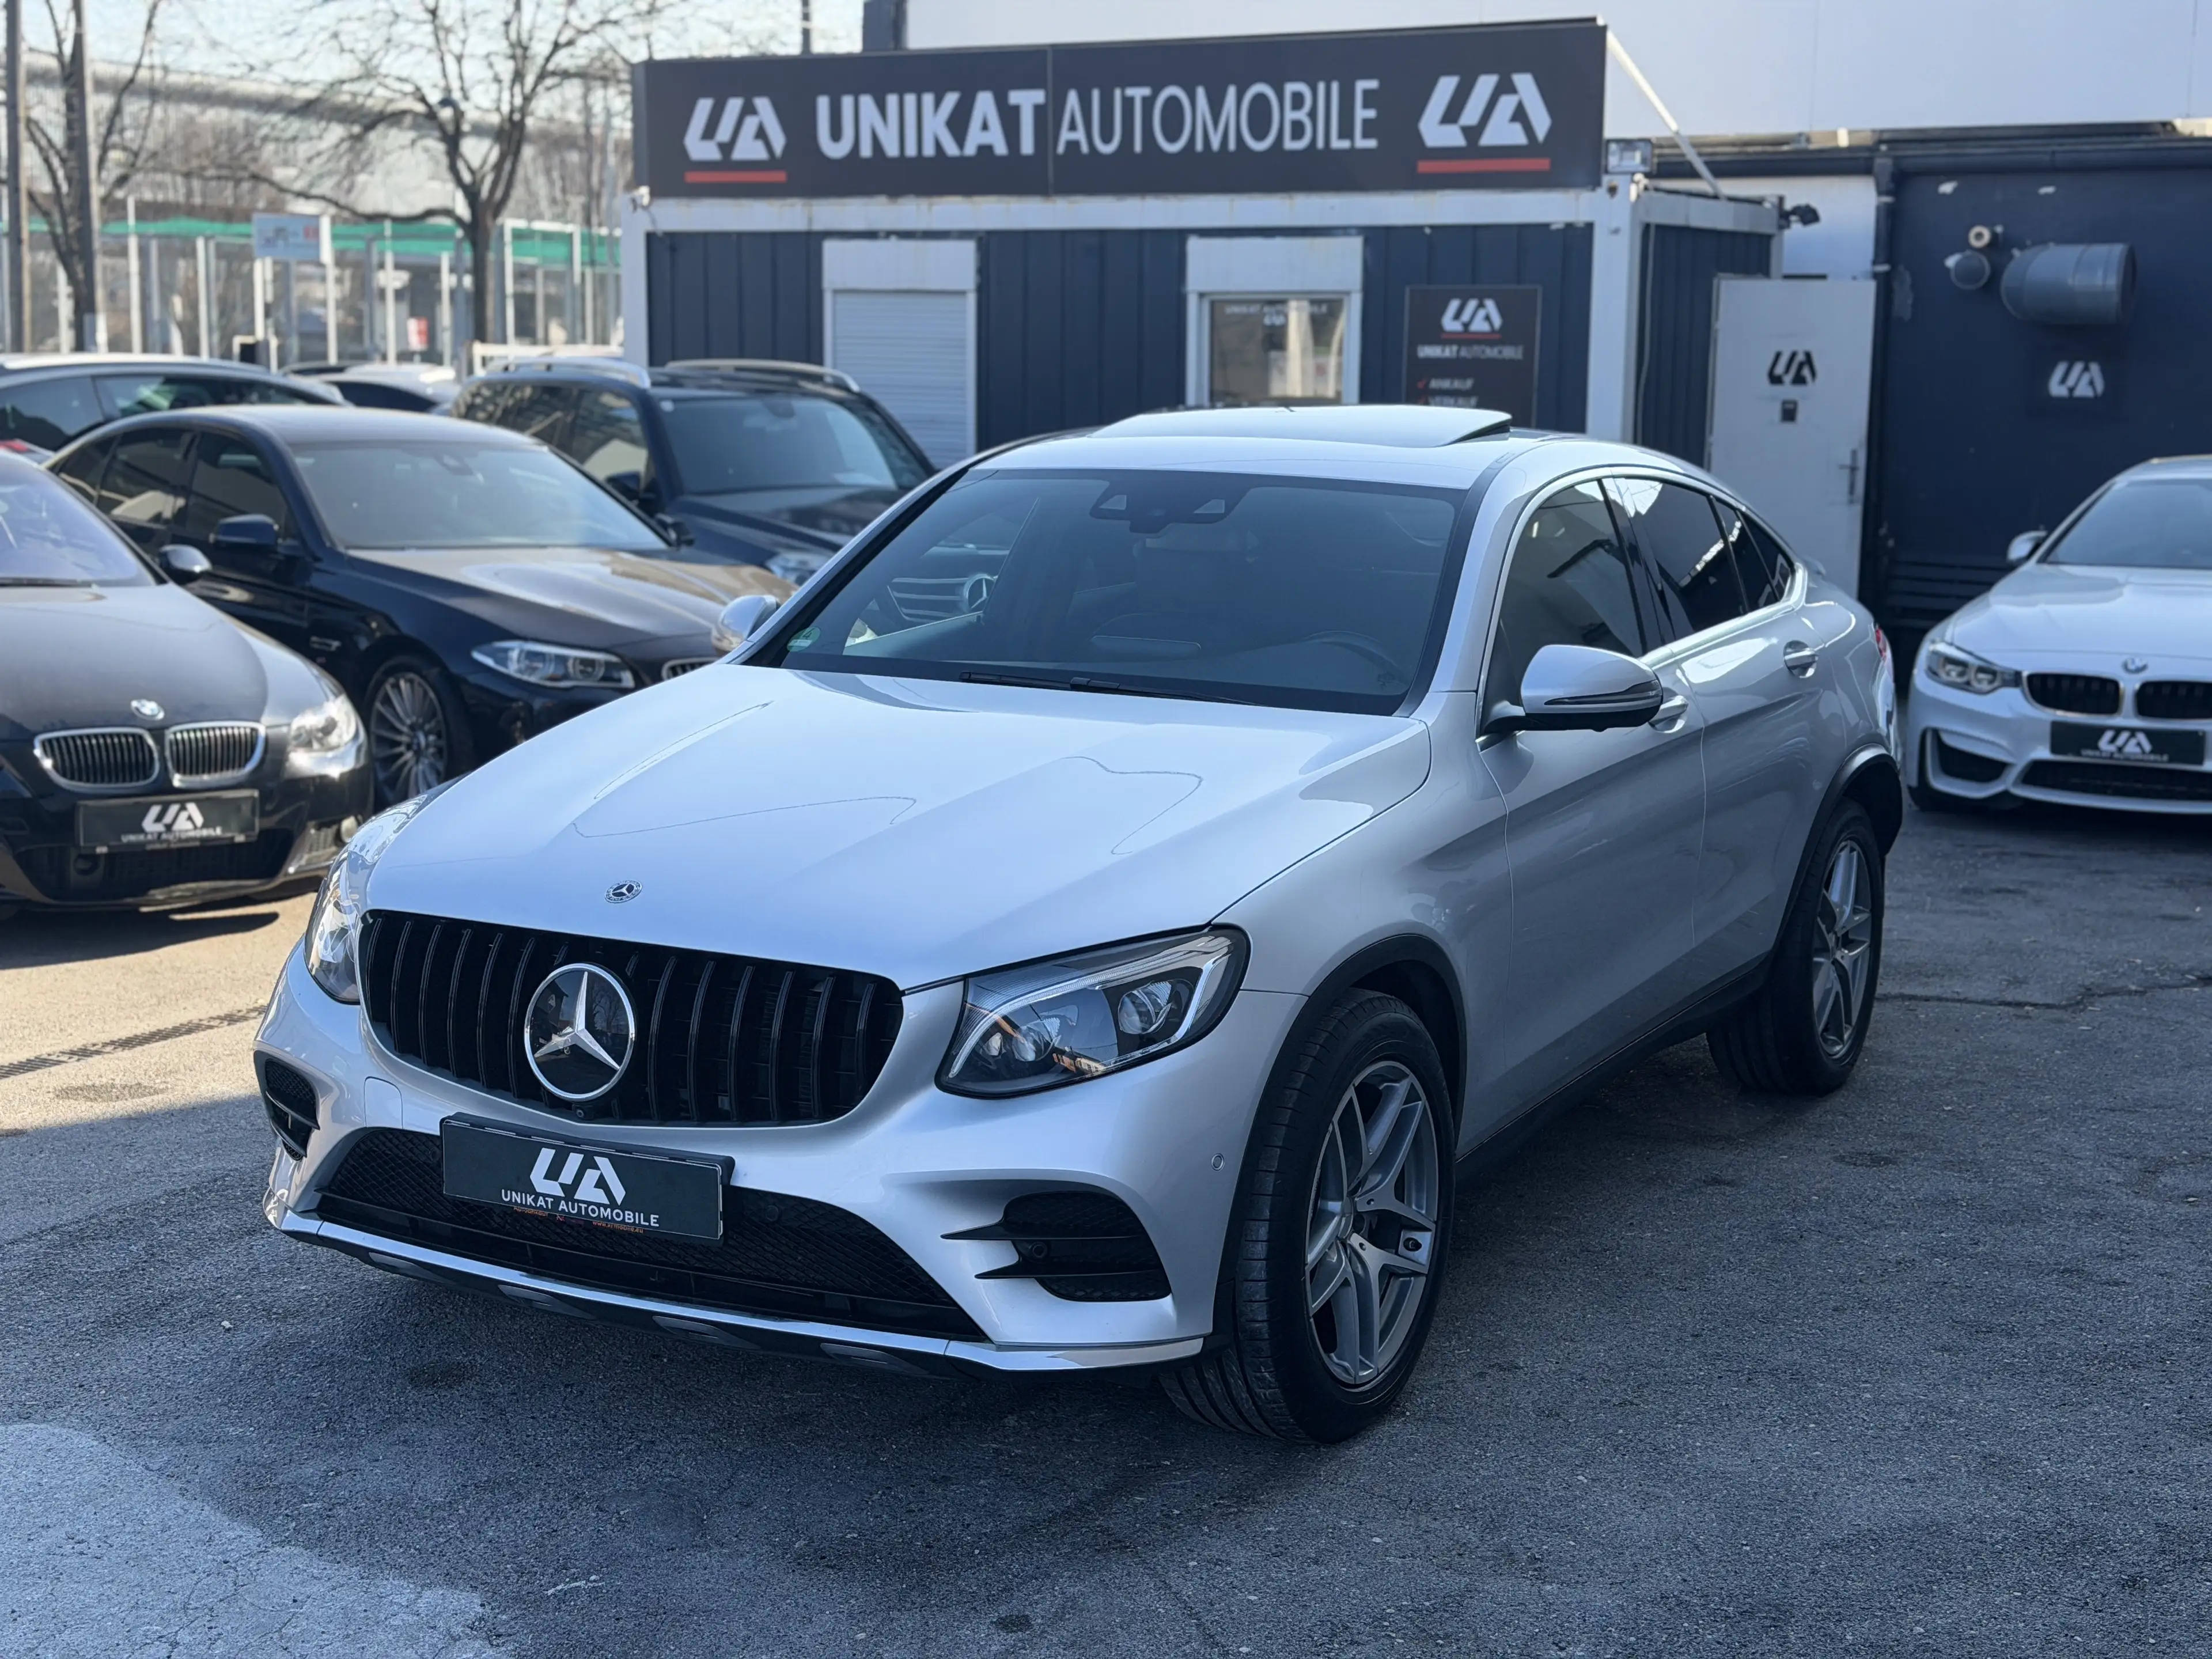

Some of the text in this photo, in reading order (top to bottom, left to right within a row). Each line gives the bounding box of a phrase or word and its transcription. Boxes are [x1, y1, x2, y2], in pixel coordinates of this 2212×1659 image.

[816, 79, 1380, 160] UNIKAT AUTOMOBILE
[1417, 344, 1523, 359] UNIKAT AUTOMOBILE
[501, 1189, 554, 1209] UNIKAT
[558, 1200, 660, 1227] AUTOMOBILE
